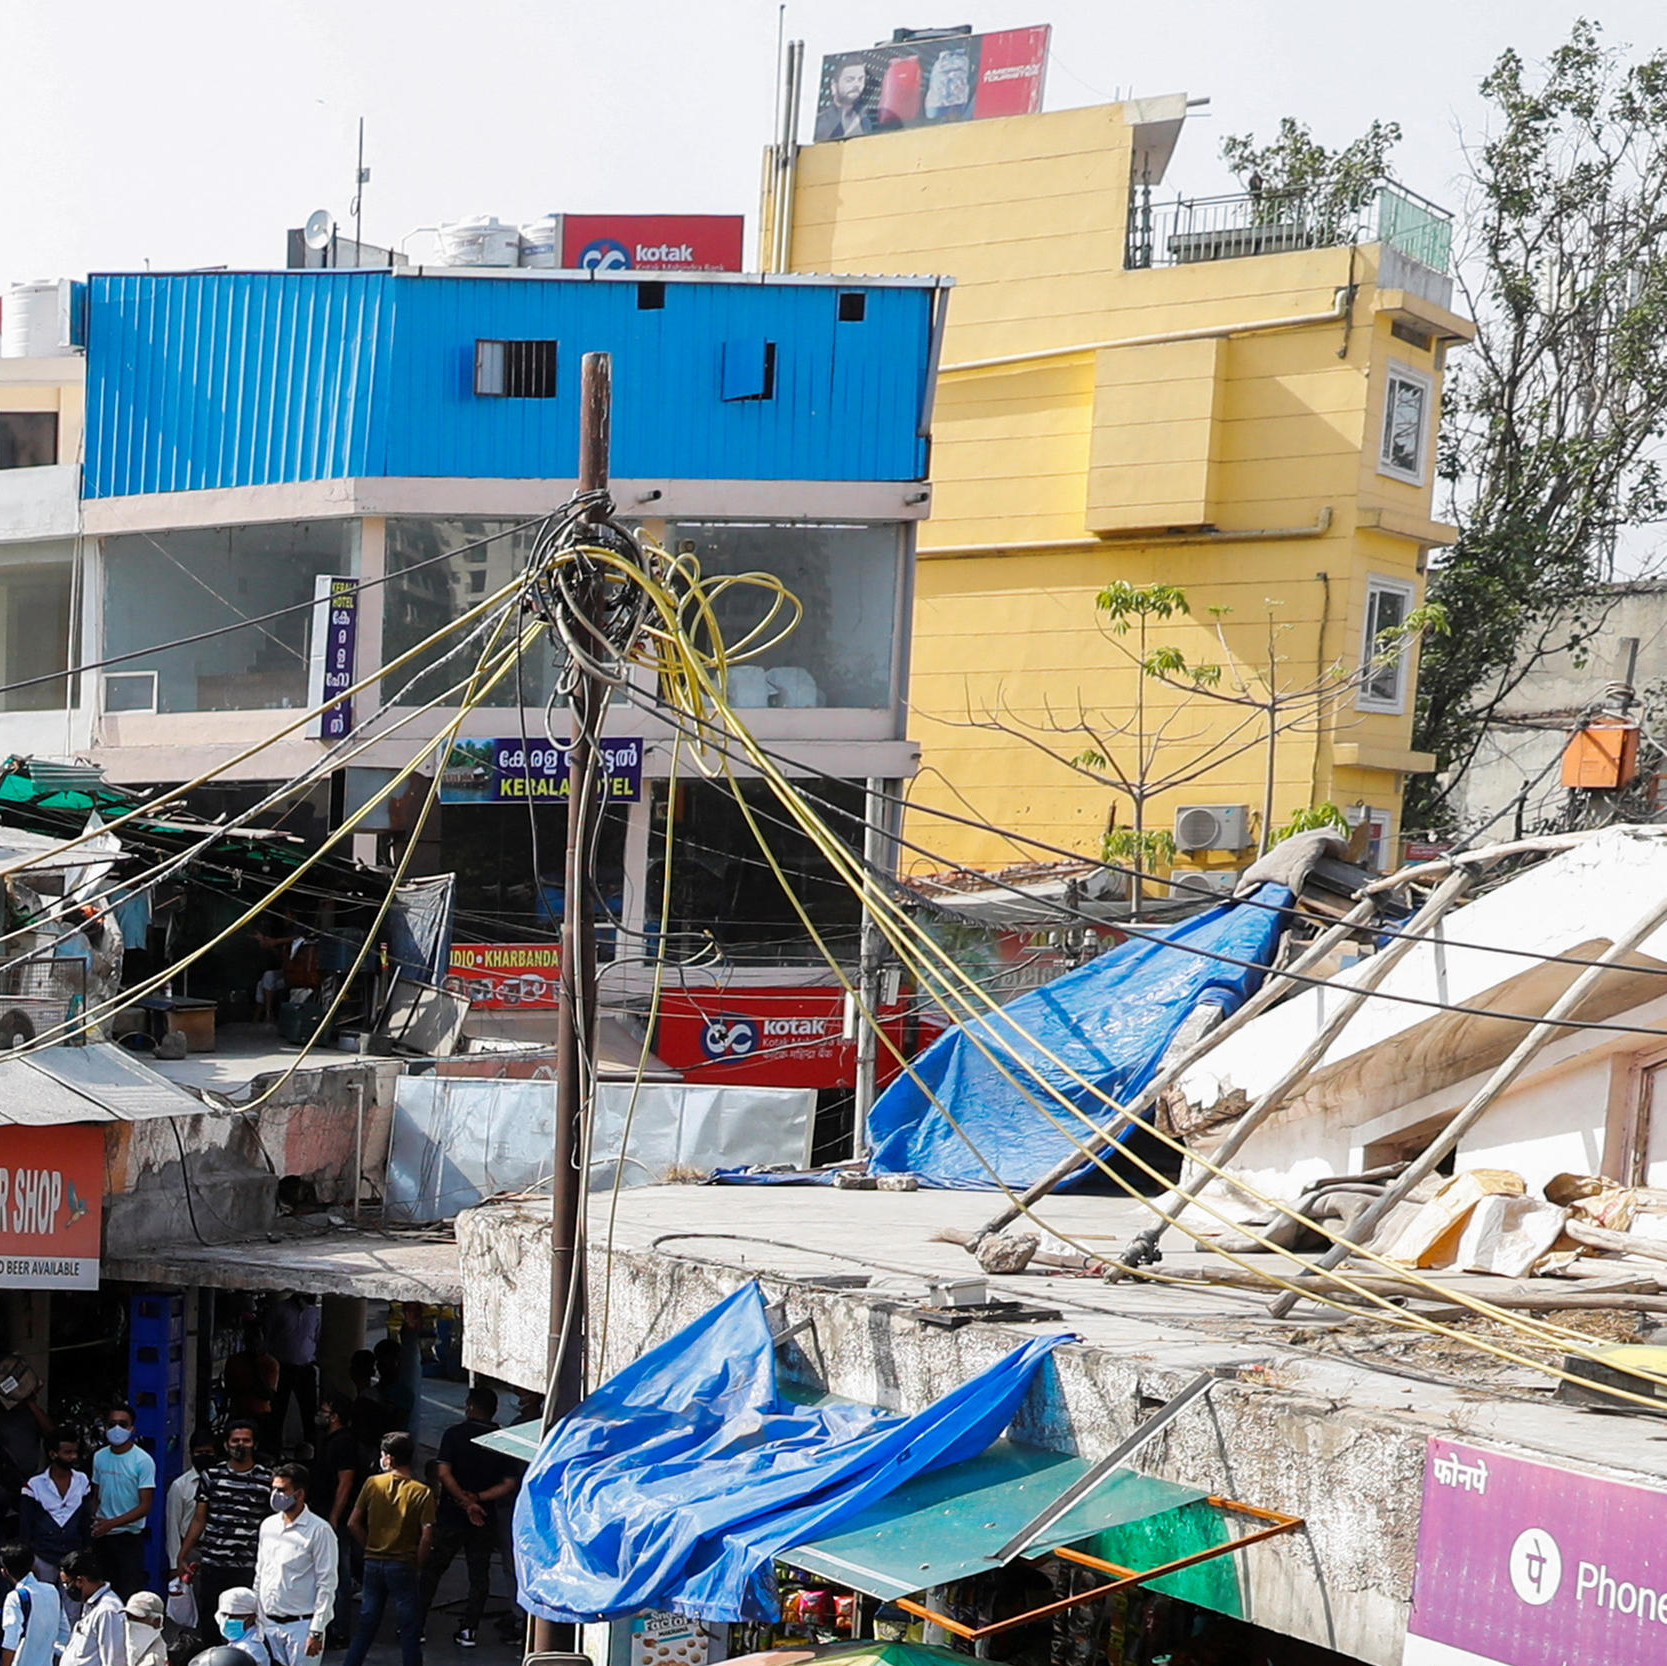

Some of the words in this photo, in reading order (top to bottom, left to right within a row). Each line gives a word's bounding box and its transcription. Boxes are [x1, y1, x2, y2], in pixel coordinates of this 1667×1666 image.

[636, 244, 694, 262] kotak
[500, 778, 571, 797] KERALA
[485, 950, 560, 967] KHARBANDA
[763, 1019, 826, 1036] kotak
[13, 1168, 62, 1235] SHOP
[6, 1262, 30, 1276] BEER
[31, 1262, 80, 1276] AVAILABLE
[1433, 1452, 1489, 1495] फोनपे
